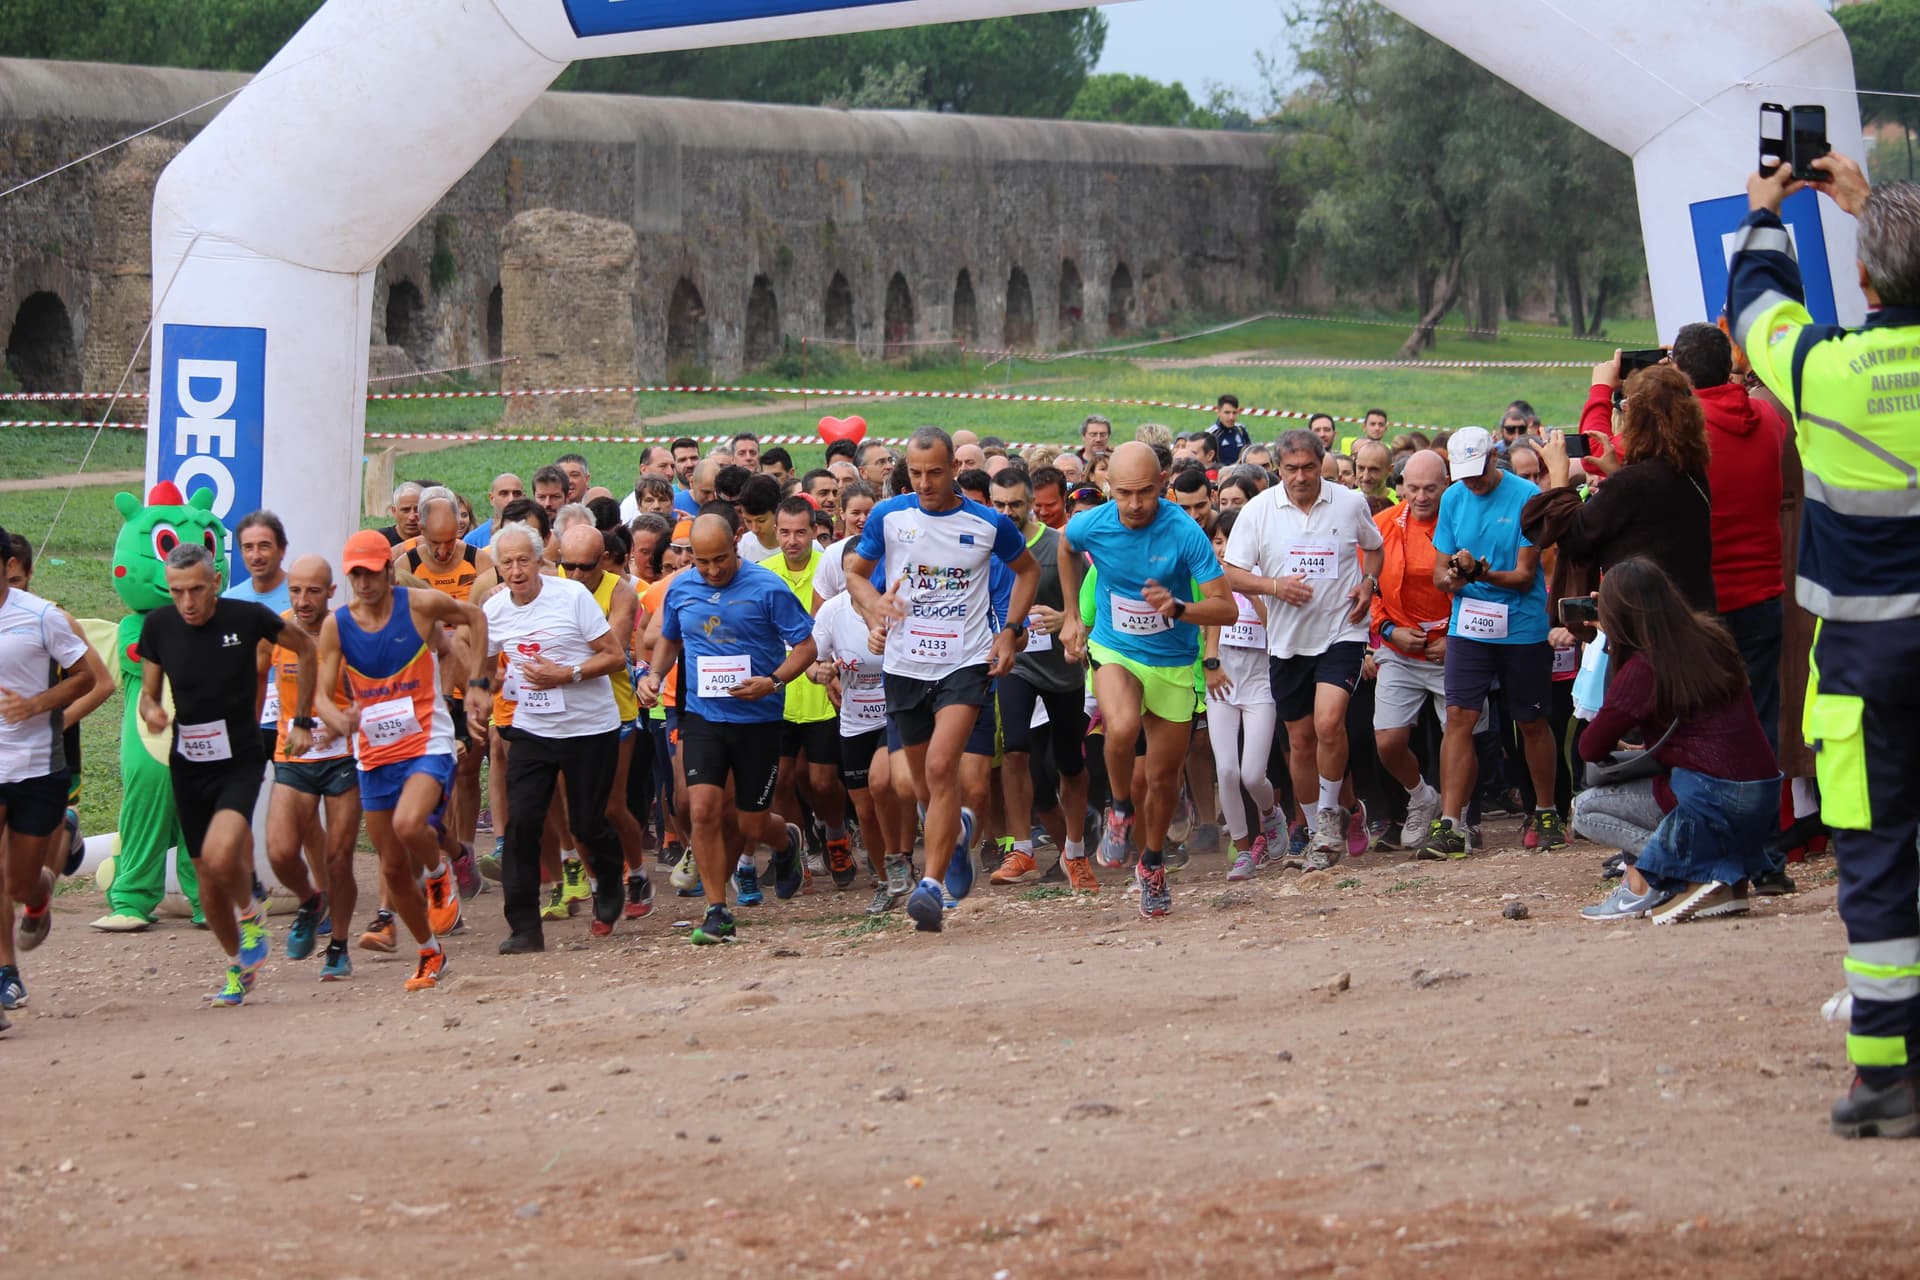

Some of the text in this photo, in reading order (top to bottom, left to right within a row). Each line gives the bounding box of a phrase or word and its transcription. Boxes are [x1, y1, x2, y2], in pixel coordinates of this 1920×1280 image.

[1849, 346, 1907, 375] CENTRO
[173, 358, 238, 552] DEC
[1299, 557, 1325, 567] A444
[912, 604, 967, 617] EUROPE
[1128, 615, 1156, 625] A127
[1471, 616, 1494, 627] A400
[919, 639, 947, 650] A133
[711, 674, 736, 684] A003
[528, 692, 549, 701] A001
[863, 704, 886, 713] A407
[377, 718, 402, 732] A326
[184, 740, 213, 750] A461
